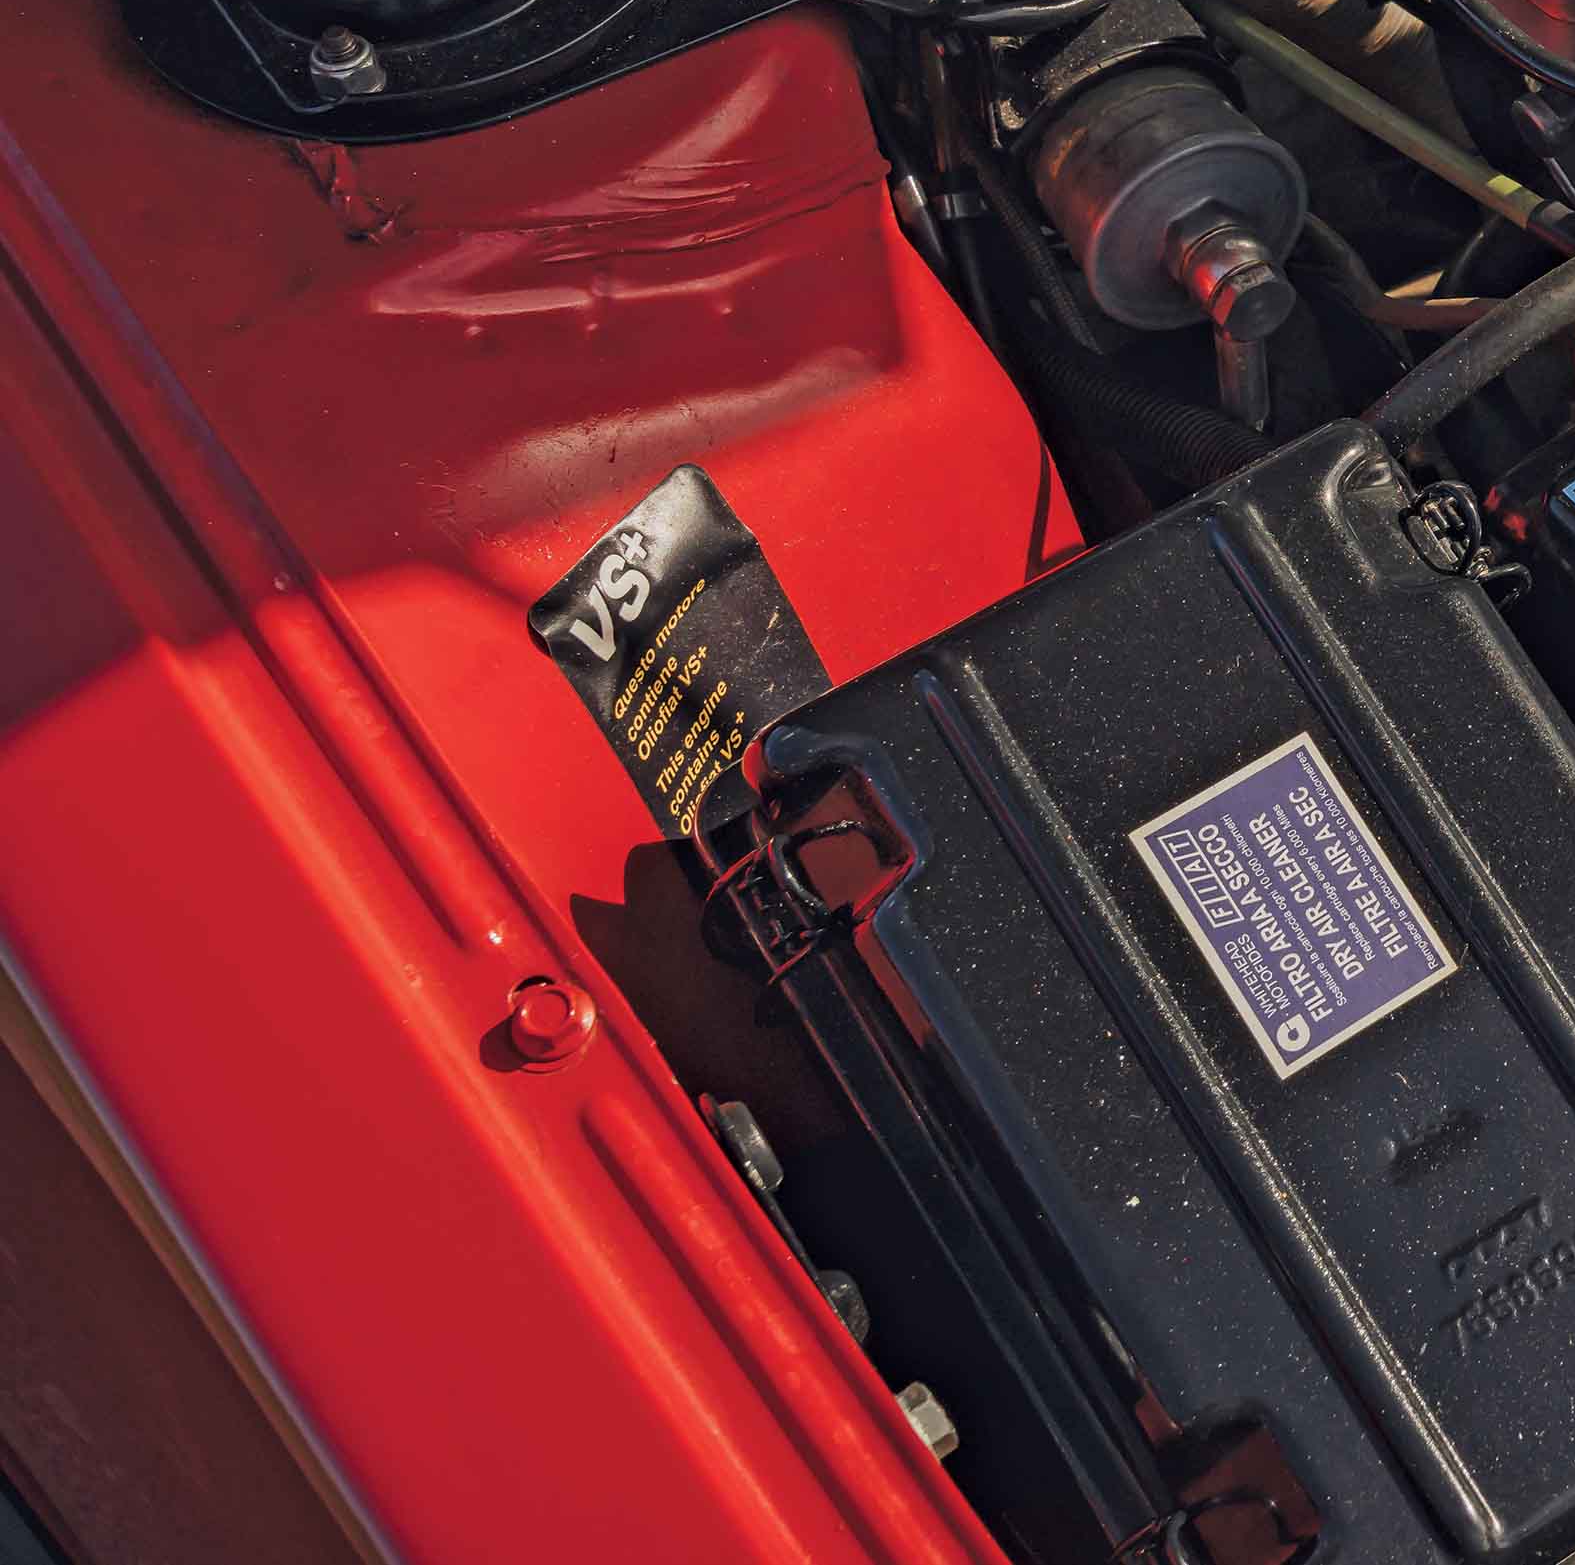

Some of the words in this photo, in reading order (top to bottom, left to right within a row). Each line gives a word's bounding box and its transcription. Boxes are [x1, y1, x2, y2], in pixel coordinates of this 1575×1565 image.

[569, 531, 650, 662] VS+
[614, 648, 656, 720] Questo
[655, 578, 706, 649] motore
[627, 655, 679, 742] contiene
[638, 685, 684, 761] Oliofiat
[677, 645, 709, 687] VS+
[656, 749, 685, 794] This
[683, 679, 728, 749] engine
[670, 729, 720, 816] contains
[1296, 751, 1329, 799] Kilometres
[1272, 804, 1292, 830] Miles
[1288, 786, 1325, 827] SEC
[1219, 813, 1252, 857] chilometri
[1314, 823, 1337, 841] A
[1346, 829, 1360, 846] les
[1198, 824, 1250, 891] SECCO
[1249, 812, 1315, 903] CLEANER
[1305, 855, 1326, 882] every
[1324, 839, 1358, 875] AIR
[1355, 844, 1373, 866] tous
[1168, 841, 1234, 919] FIAT
[1240, 887, 1262, 906] A
[1270, 889, 1288, 910] ogni
[1323, 882, 1350, 922] cartridge
[1346, 873, 1369, 892] A
[1369, 865, 1401, 910] cartouche
[1251, 903, 1292, 952] ARIA
[1284, 910, 1313, 952] cartuccia
[1305, 901, 1340, 937] AIR
[1355, 890, 1409, 958] FILTRE
[1398, 909, 1408, 922] la
[1310, 952, 1321, 965] la
[1325, 938, 1365, 980] DRY
[1348, 922, 1376, 961] Replace
[1404, 920, 1439, 970] Remplacer
[1224, 940, 1277, 1018] WHITEHEAD
[1238, 933, 1291, 1010] MOTOFIDES
[1280, 952, 1333, 1022] FILTRO
[1317, 962, 1347, 1007] Sostituire
